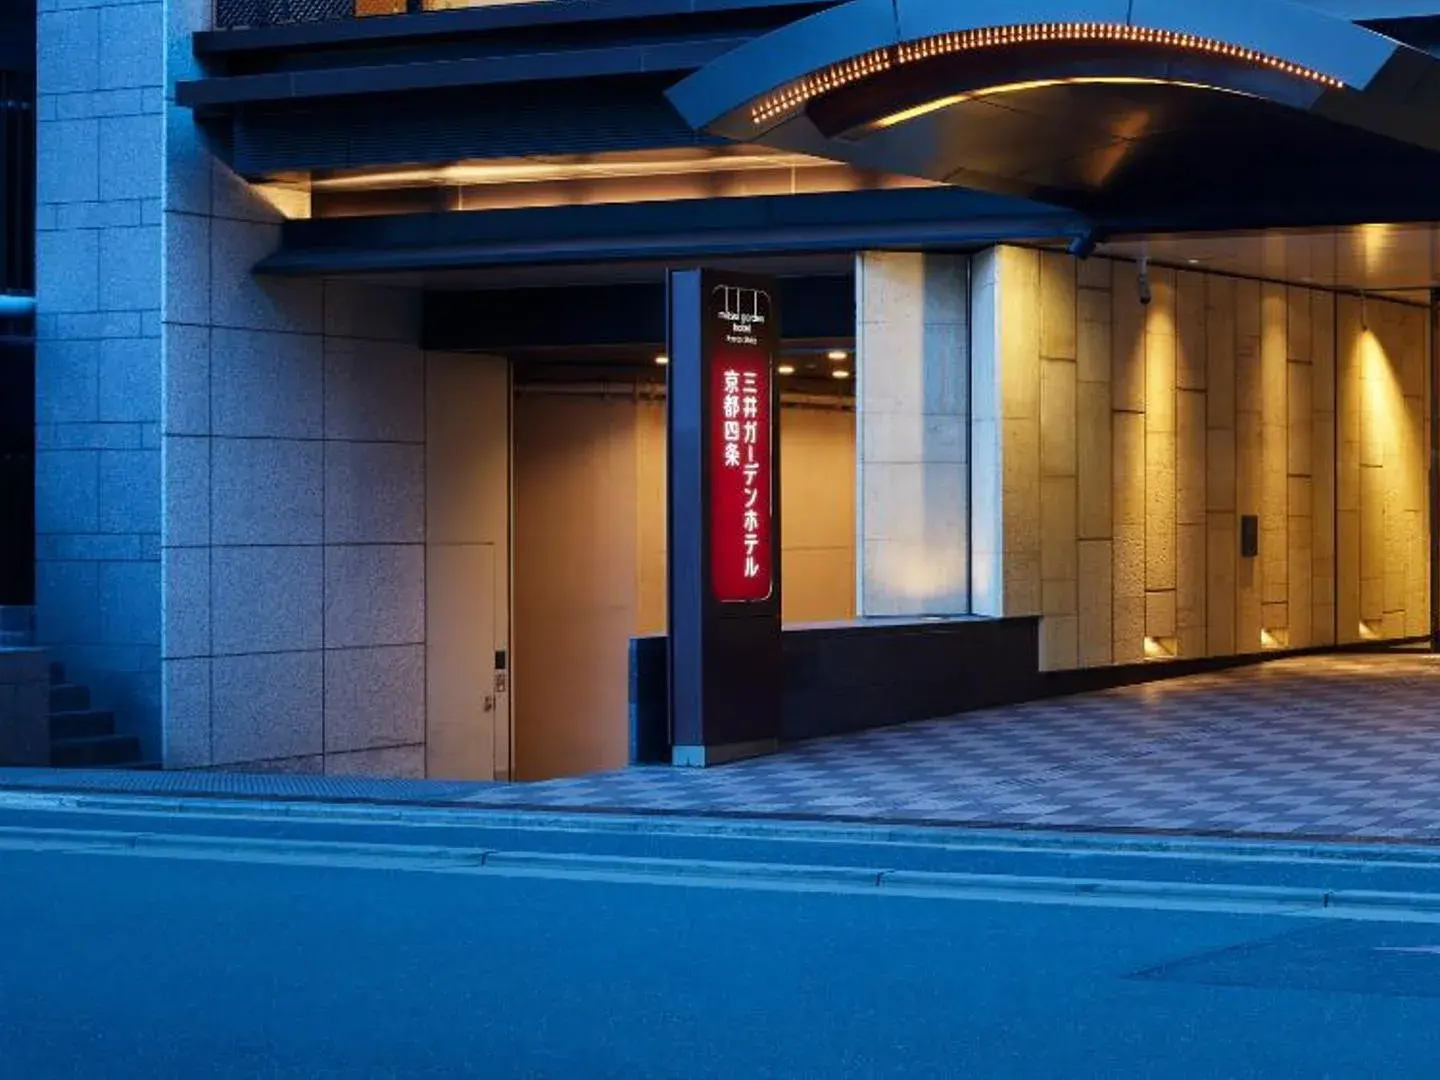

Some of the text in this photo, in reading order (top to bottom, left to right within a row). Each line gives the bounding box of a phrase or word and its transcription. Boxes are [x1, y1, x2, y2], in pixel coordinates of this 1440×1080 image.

[723, 369, 740, 467] 京都四条
[743, 371, 759, 577] 三井ガーデンホテル
